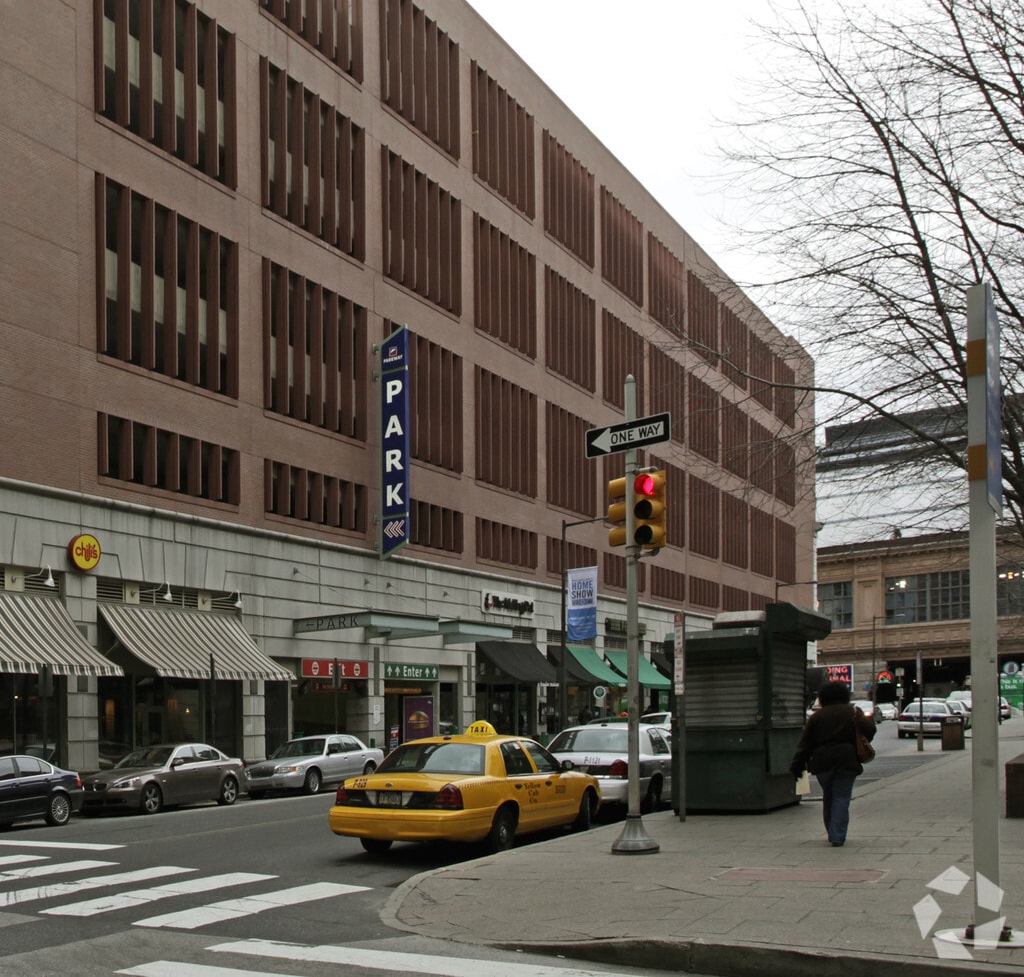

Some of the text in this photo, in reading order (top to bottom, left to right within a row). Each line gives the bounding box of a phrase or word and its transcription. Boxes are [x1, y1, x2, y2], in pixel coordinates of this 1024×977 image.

[383, 354, 403, 363] PARKWAY
[610, 423, 661, 444] ONE WAY
[384, 379, 404, 507] PARK
[75, 541, 98, 562] chili's
[571, 580, 593, 591] HOME
[571, 589, 593, 599] SHOW
[316, 615, 359, 630] PARK
[328, 662, 346, 676] Et
[403, 666, 423, 678] Enter
[523, 782, 541, 790] Yellow
[528, 789, 539, 797] Cab
